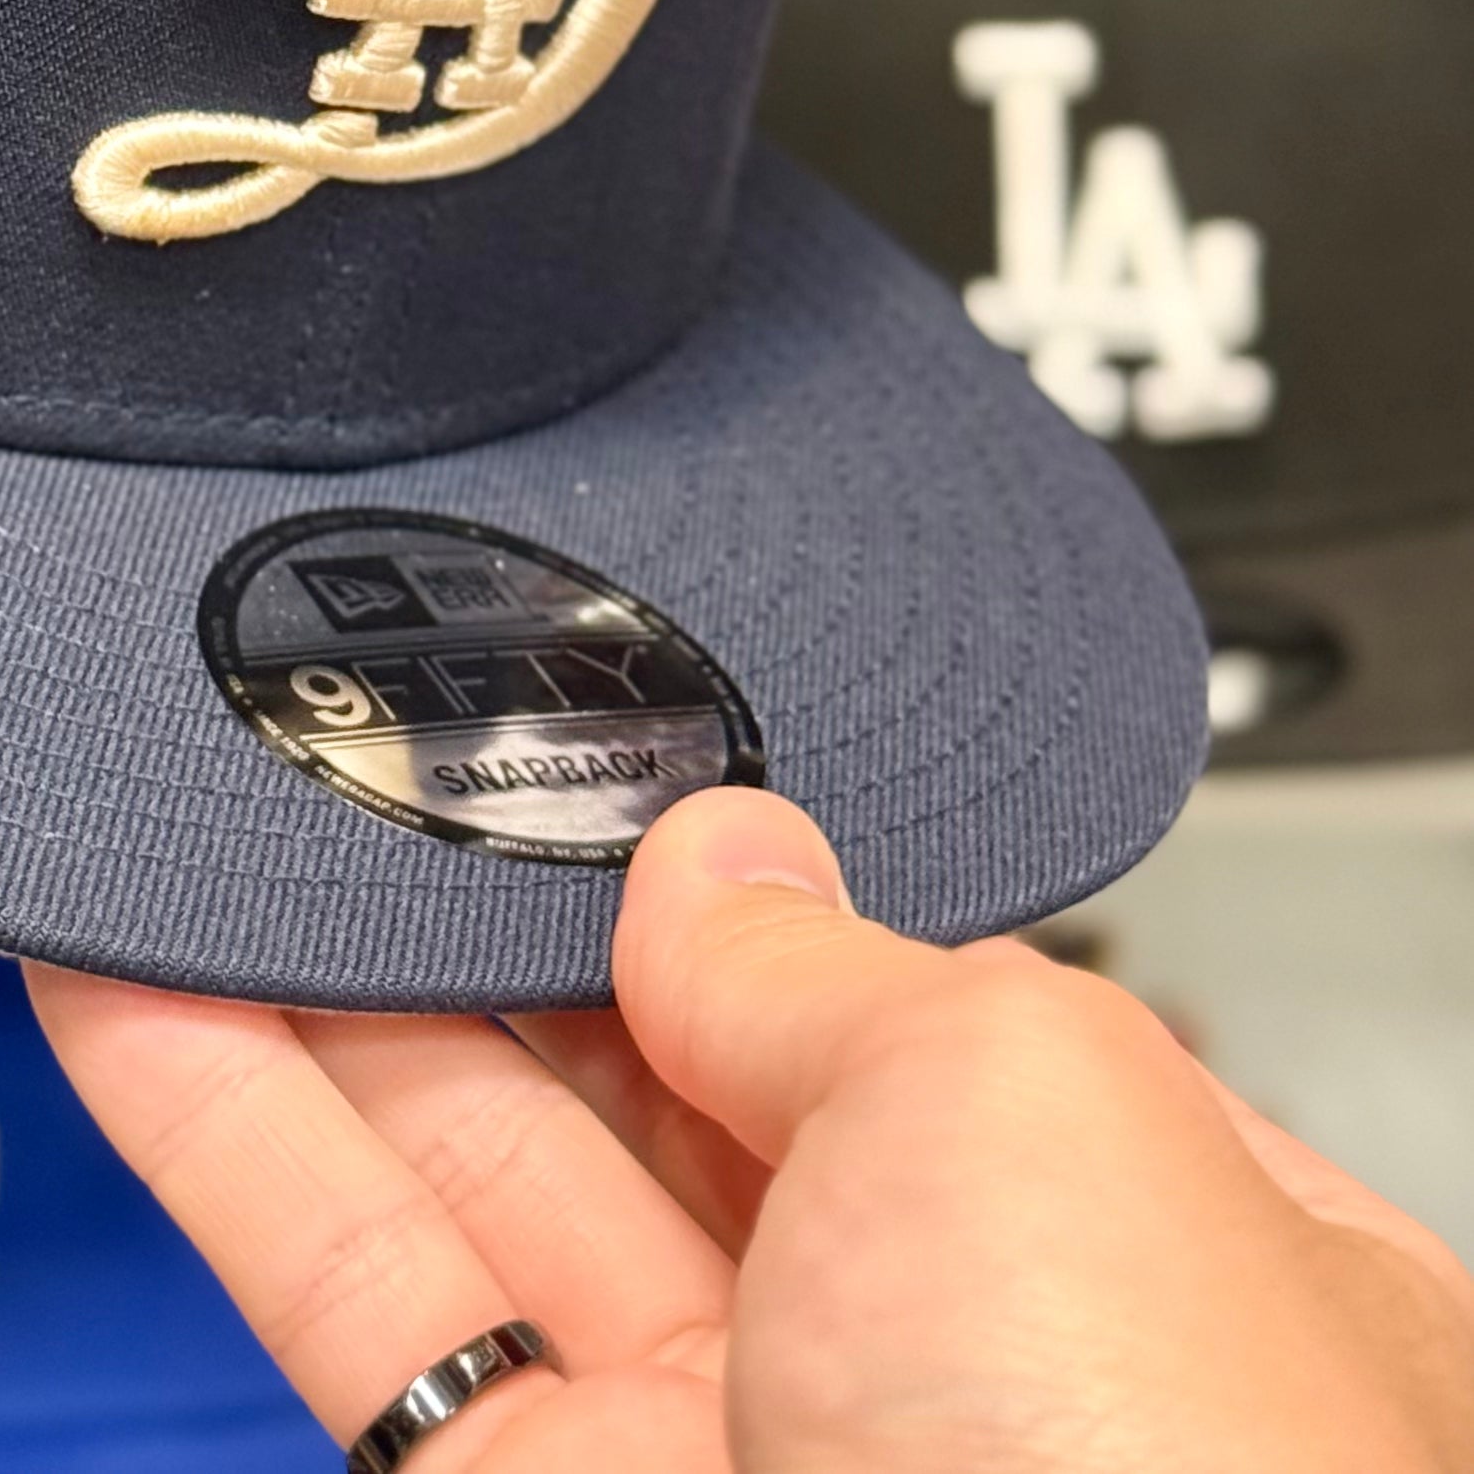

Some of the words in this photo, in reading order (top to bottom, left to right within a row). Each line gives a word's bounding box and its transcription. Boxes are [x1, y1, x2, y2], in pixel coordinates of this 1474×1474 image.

[953, 20, 1274, 442] LA
[431, 583, 512, 611] ERA
[433, 748, 670, 795] SNAPBACK
